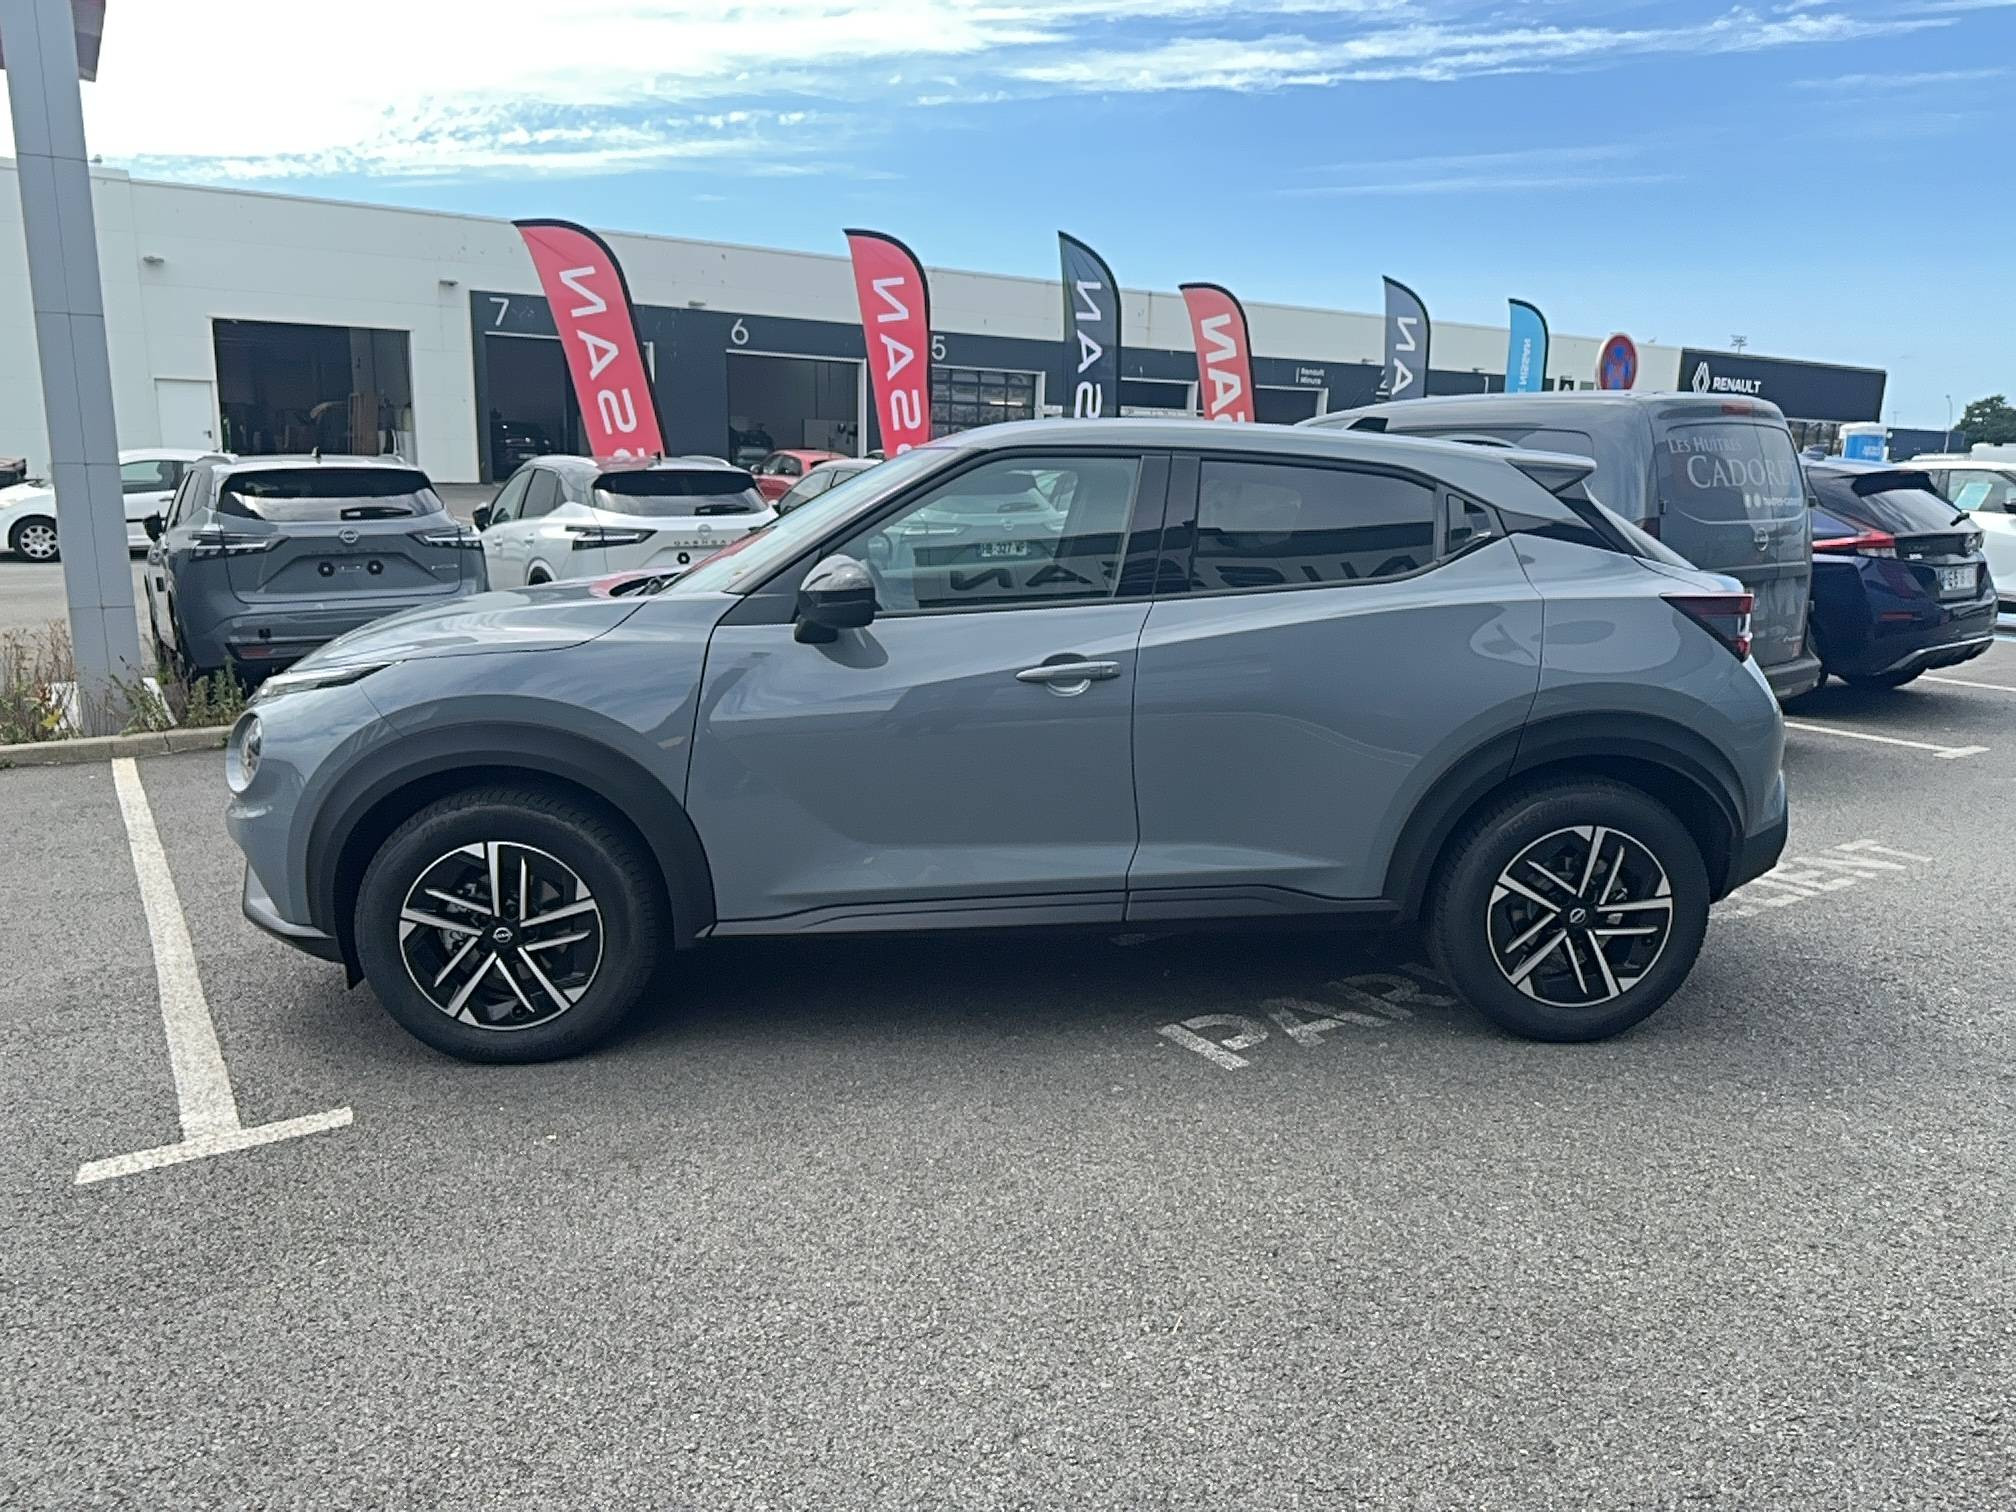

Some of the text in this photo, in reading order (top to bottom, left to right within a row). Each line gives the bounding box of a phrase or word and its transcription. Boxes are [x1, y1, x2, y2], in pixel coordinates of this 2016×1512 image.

[489, 297, 509, 326] 7
[731, 318, 749, 345] 6
[931, 335, 946, 360] 5
[1712, 376, 1761, 394] RENAULT
[1687, 454, 1798, 489] CADORET
